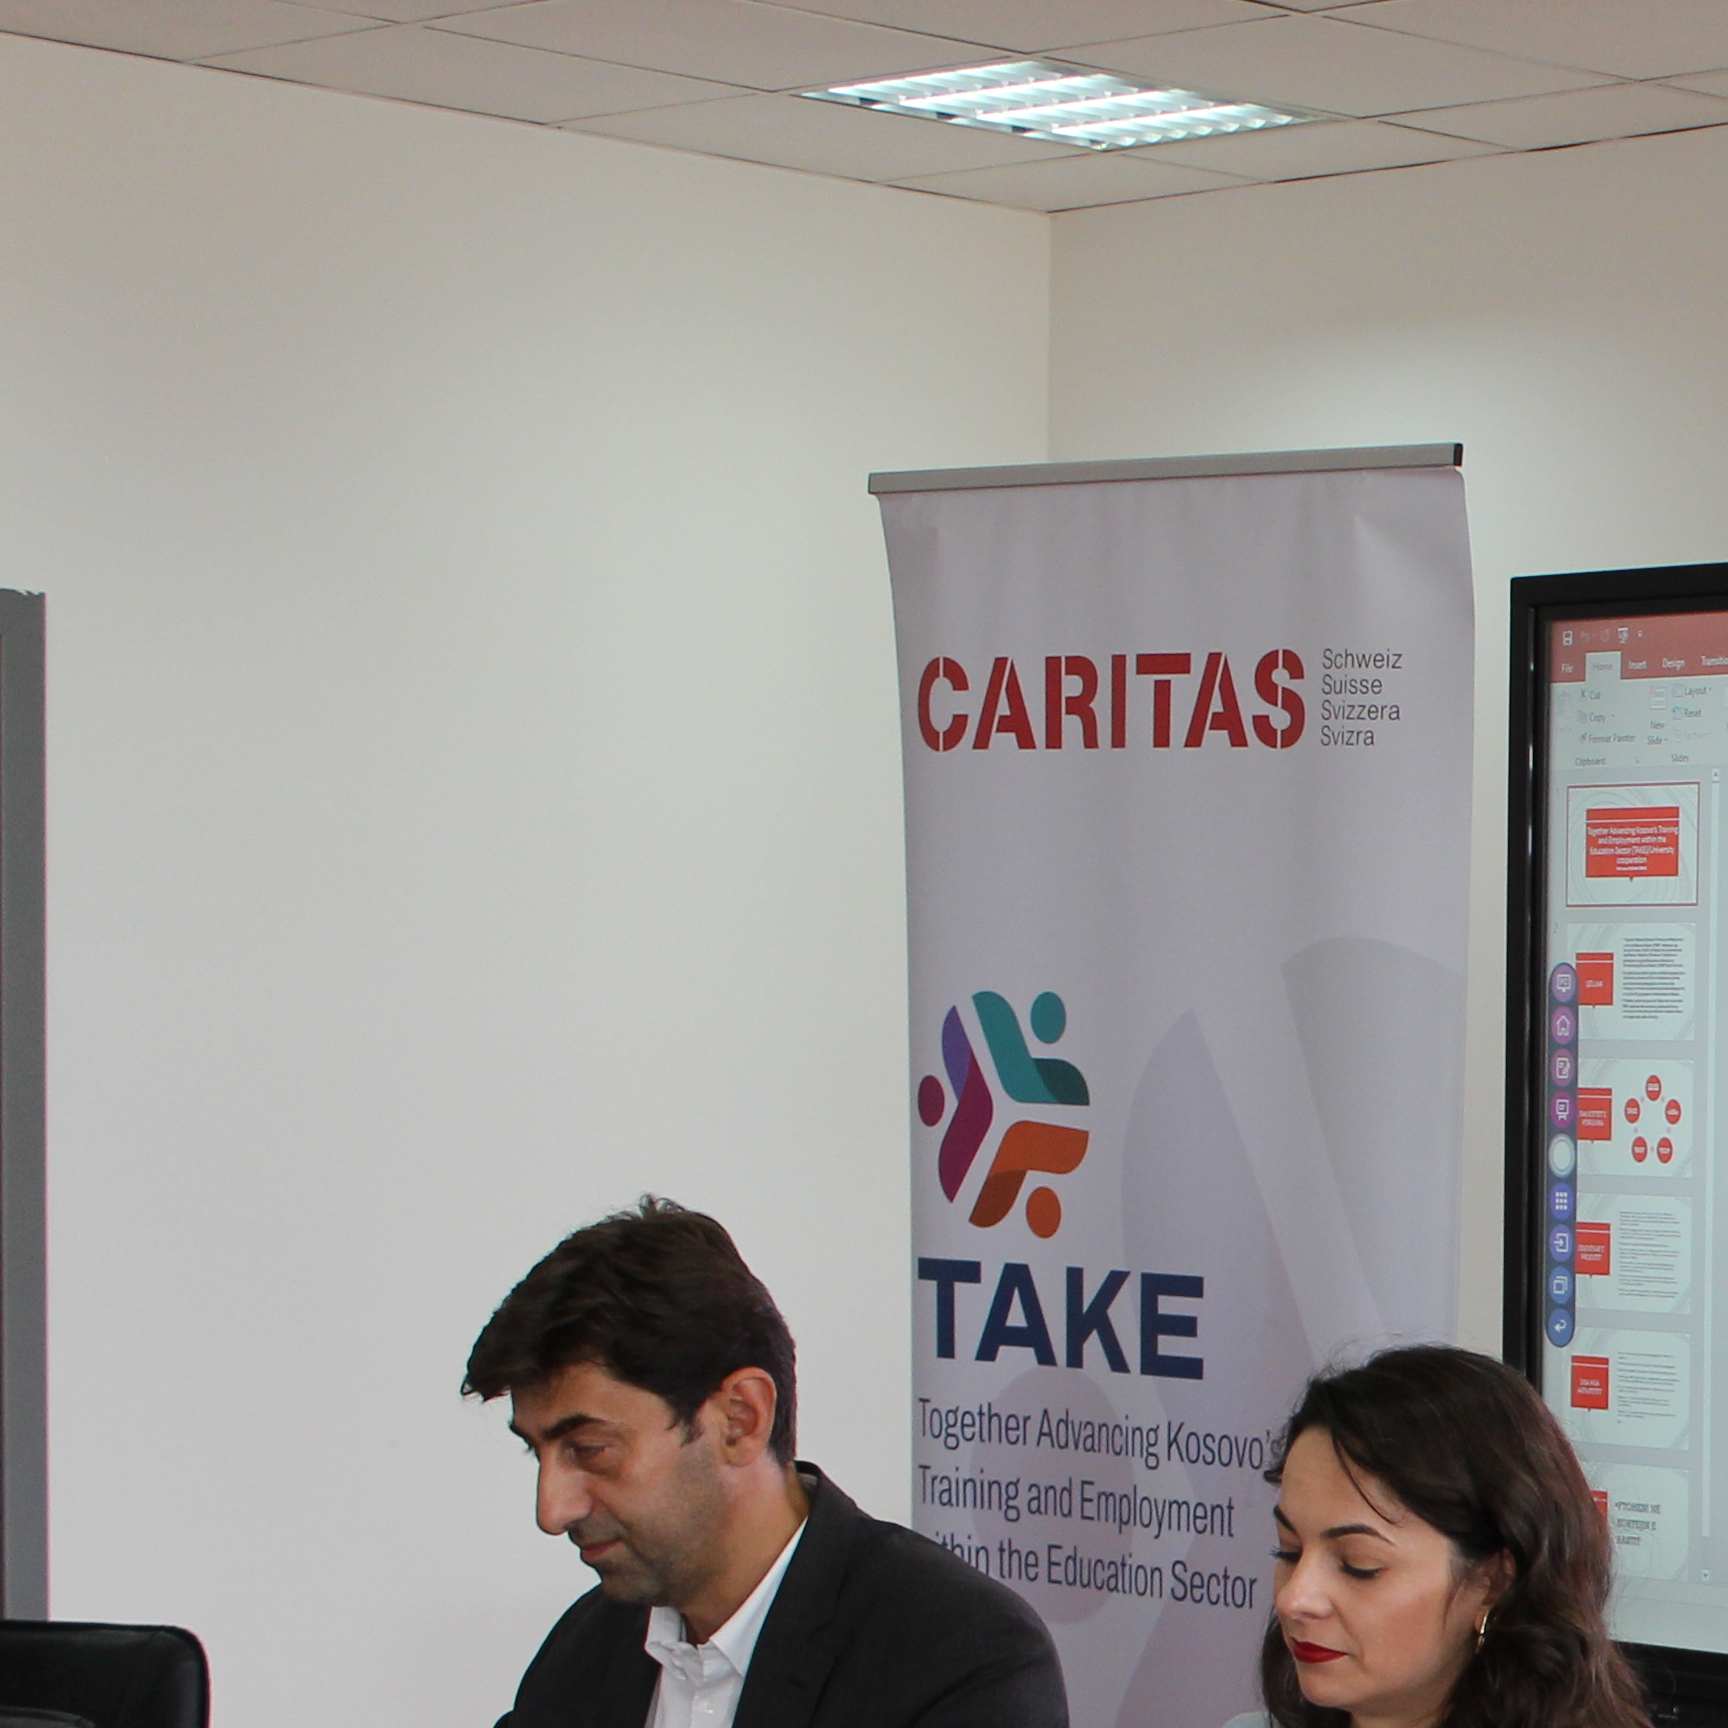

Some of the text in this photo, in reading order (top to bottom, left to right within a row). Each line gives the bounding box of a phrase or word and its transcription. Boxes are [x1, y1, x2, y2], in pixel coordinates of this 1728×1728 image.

[1321, 647, 1403, 671] Schweiz
[1561, 663, 1573, 674] File
[1592, 661, 1613, 672] Home
[1628, 660, 1647, 670] Insert
[1662, 657, 1685, 671] Design
[1321, 673, 1383, 696] Suisse
[1684, 686, 1709, 699] Layout
[917, 647, 1306, 753] CARITAS
[1320, 699, 1401, 723] Svizzera
[1589, 712, 1606, 724] Copy
[1684, 708, 1702, 718] Reset
[1650, 720, 1666, 731] New
[1319, 724, 1375, 748] Svizra
[1588, 732, 1636, 745] Format Painter
[1646, 735, 1664, 746] Slide
[1575, 756, 1607, 768] Clipboard
[1671, 753, 1690, 764] Slides
[917, 1256, 1205, 1381] TAKE
[918, 1397, 1281, 1471] Together Advancing Kosovo'
[918, 1464, 1235, 1540] Training and Employment
[997, 1537, 1039, 1582] the
[1047, 1543, 1164, 1600] Education
[1170, 1558, 1258, 1610] Sector
